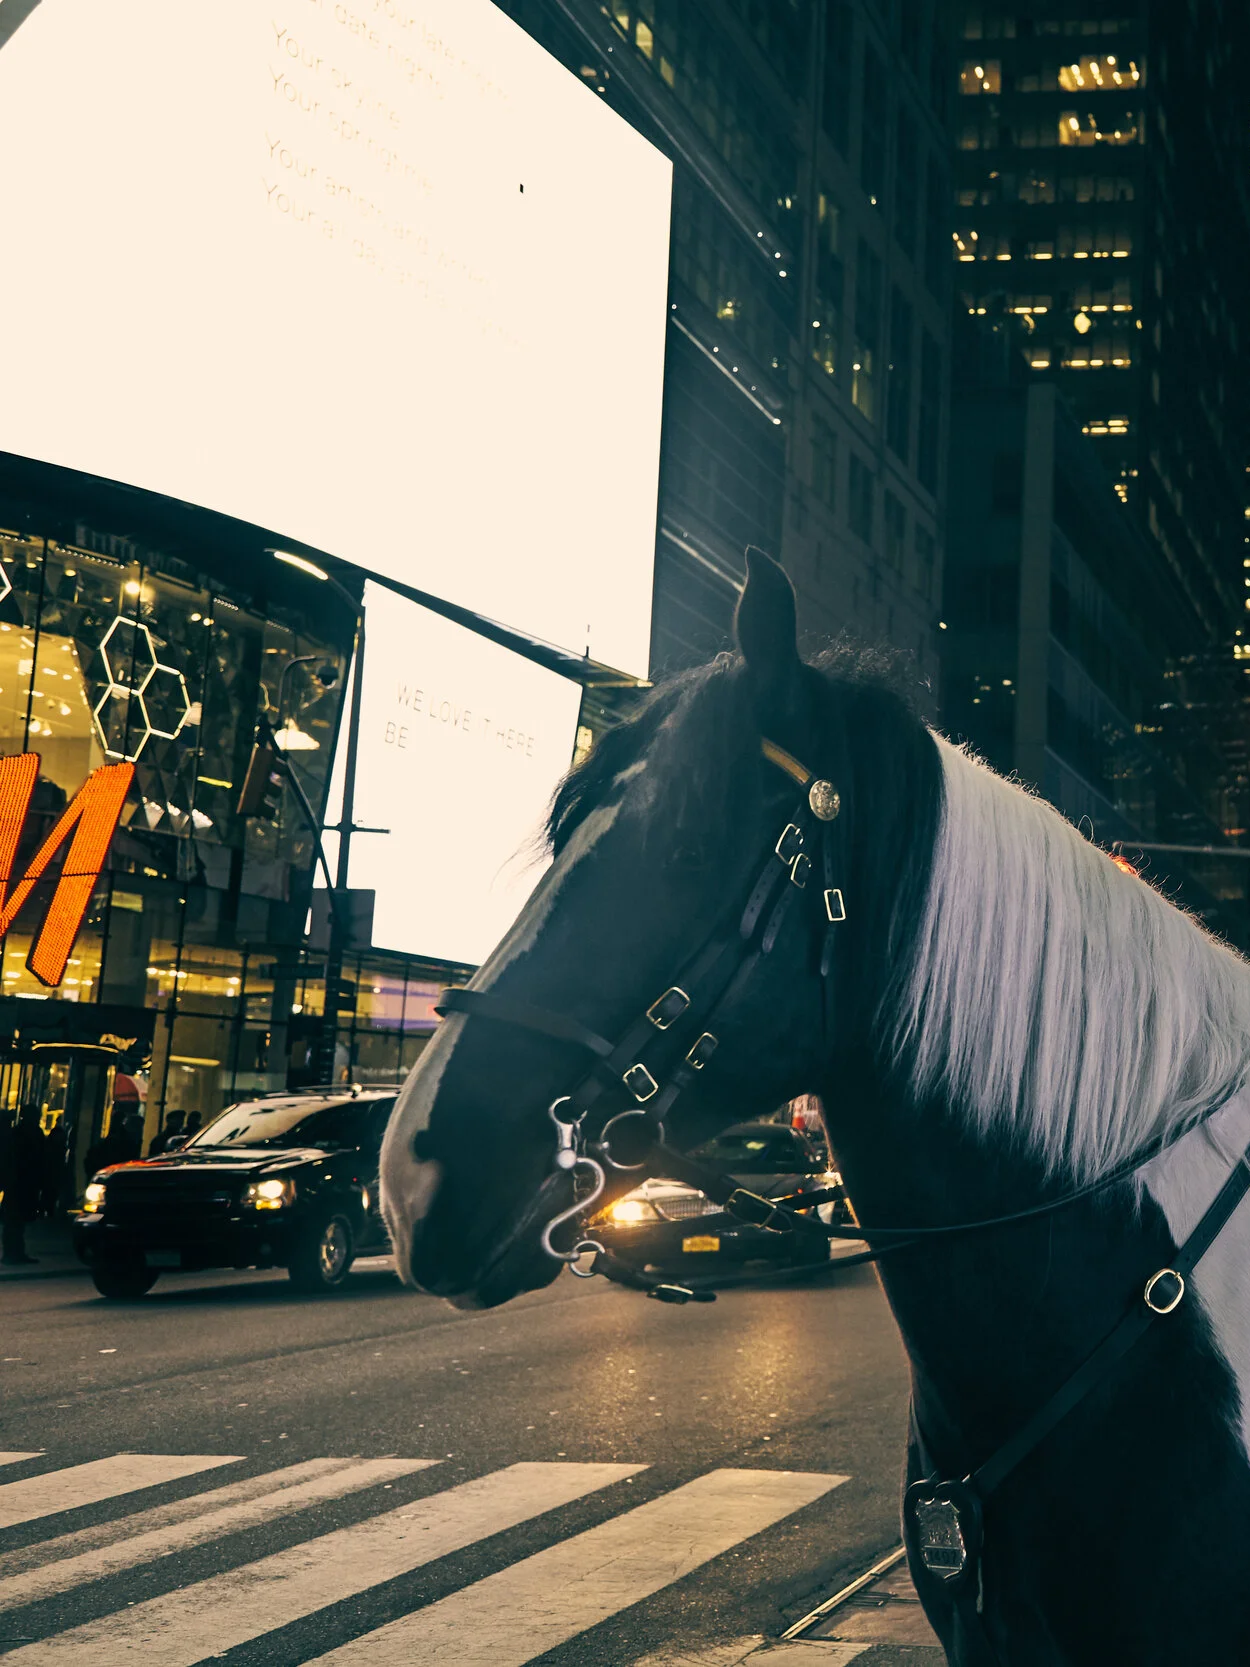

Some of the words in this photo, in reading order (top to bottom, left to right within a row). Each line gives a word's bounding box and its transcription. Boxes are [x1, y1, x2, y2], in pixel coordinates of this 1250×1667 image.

[270, 18, 324, 73] Your
[266, 62, 320, 116] Your
[264, 129, 317, 184] Your
[259, 175, 316, 226] Your
[397, 680, 425, 713] WE
[429, 694, 472, 733] LOVE
[384, 721, 409, 749] BE
